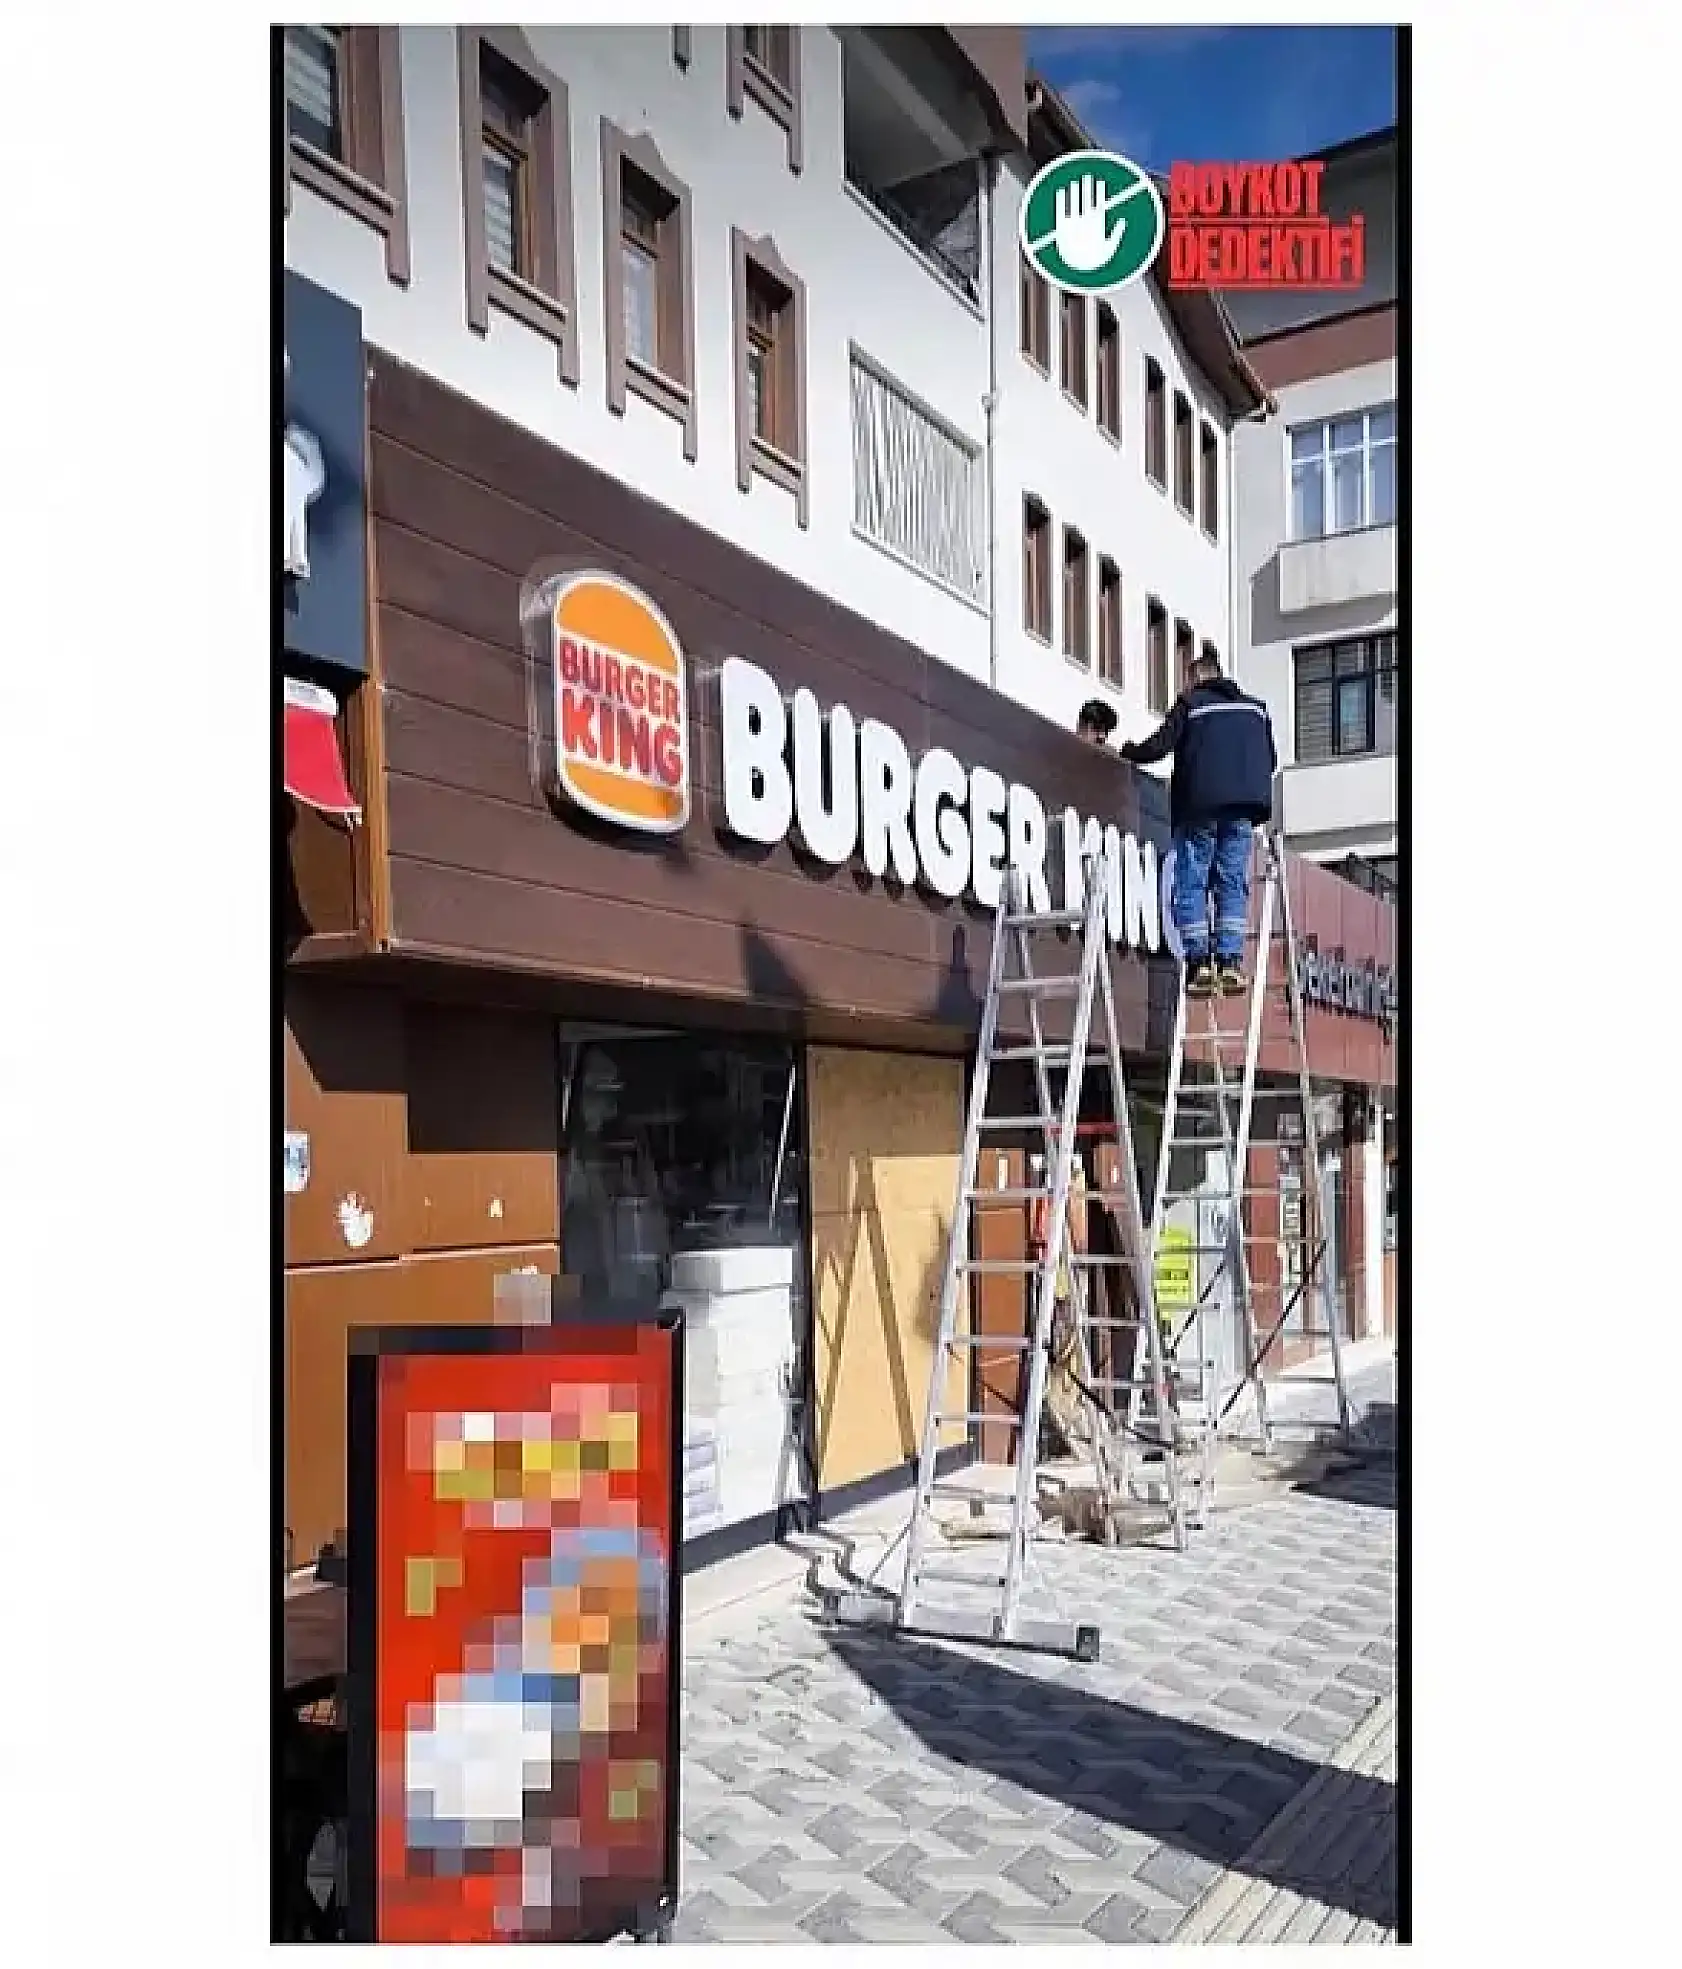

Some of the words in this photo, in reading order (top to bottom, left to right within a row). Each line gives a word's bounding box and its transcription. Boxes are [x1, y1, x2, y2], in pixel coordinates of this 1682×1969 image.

[560, 637, 681, 723] BURGER
[562, 689, 683, 785] KING
[721, 657, 1050, 914] BURGER
